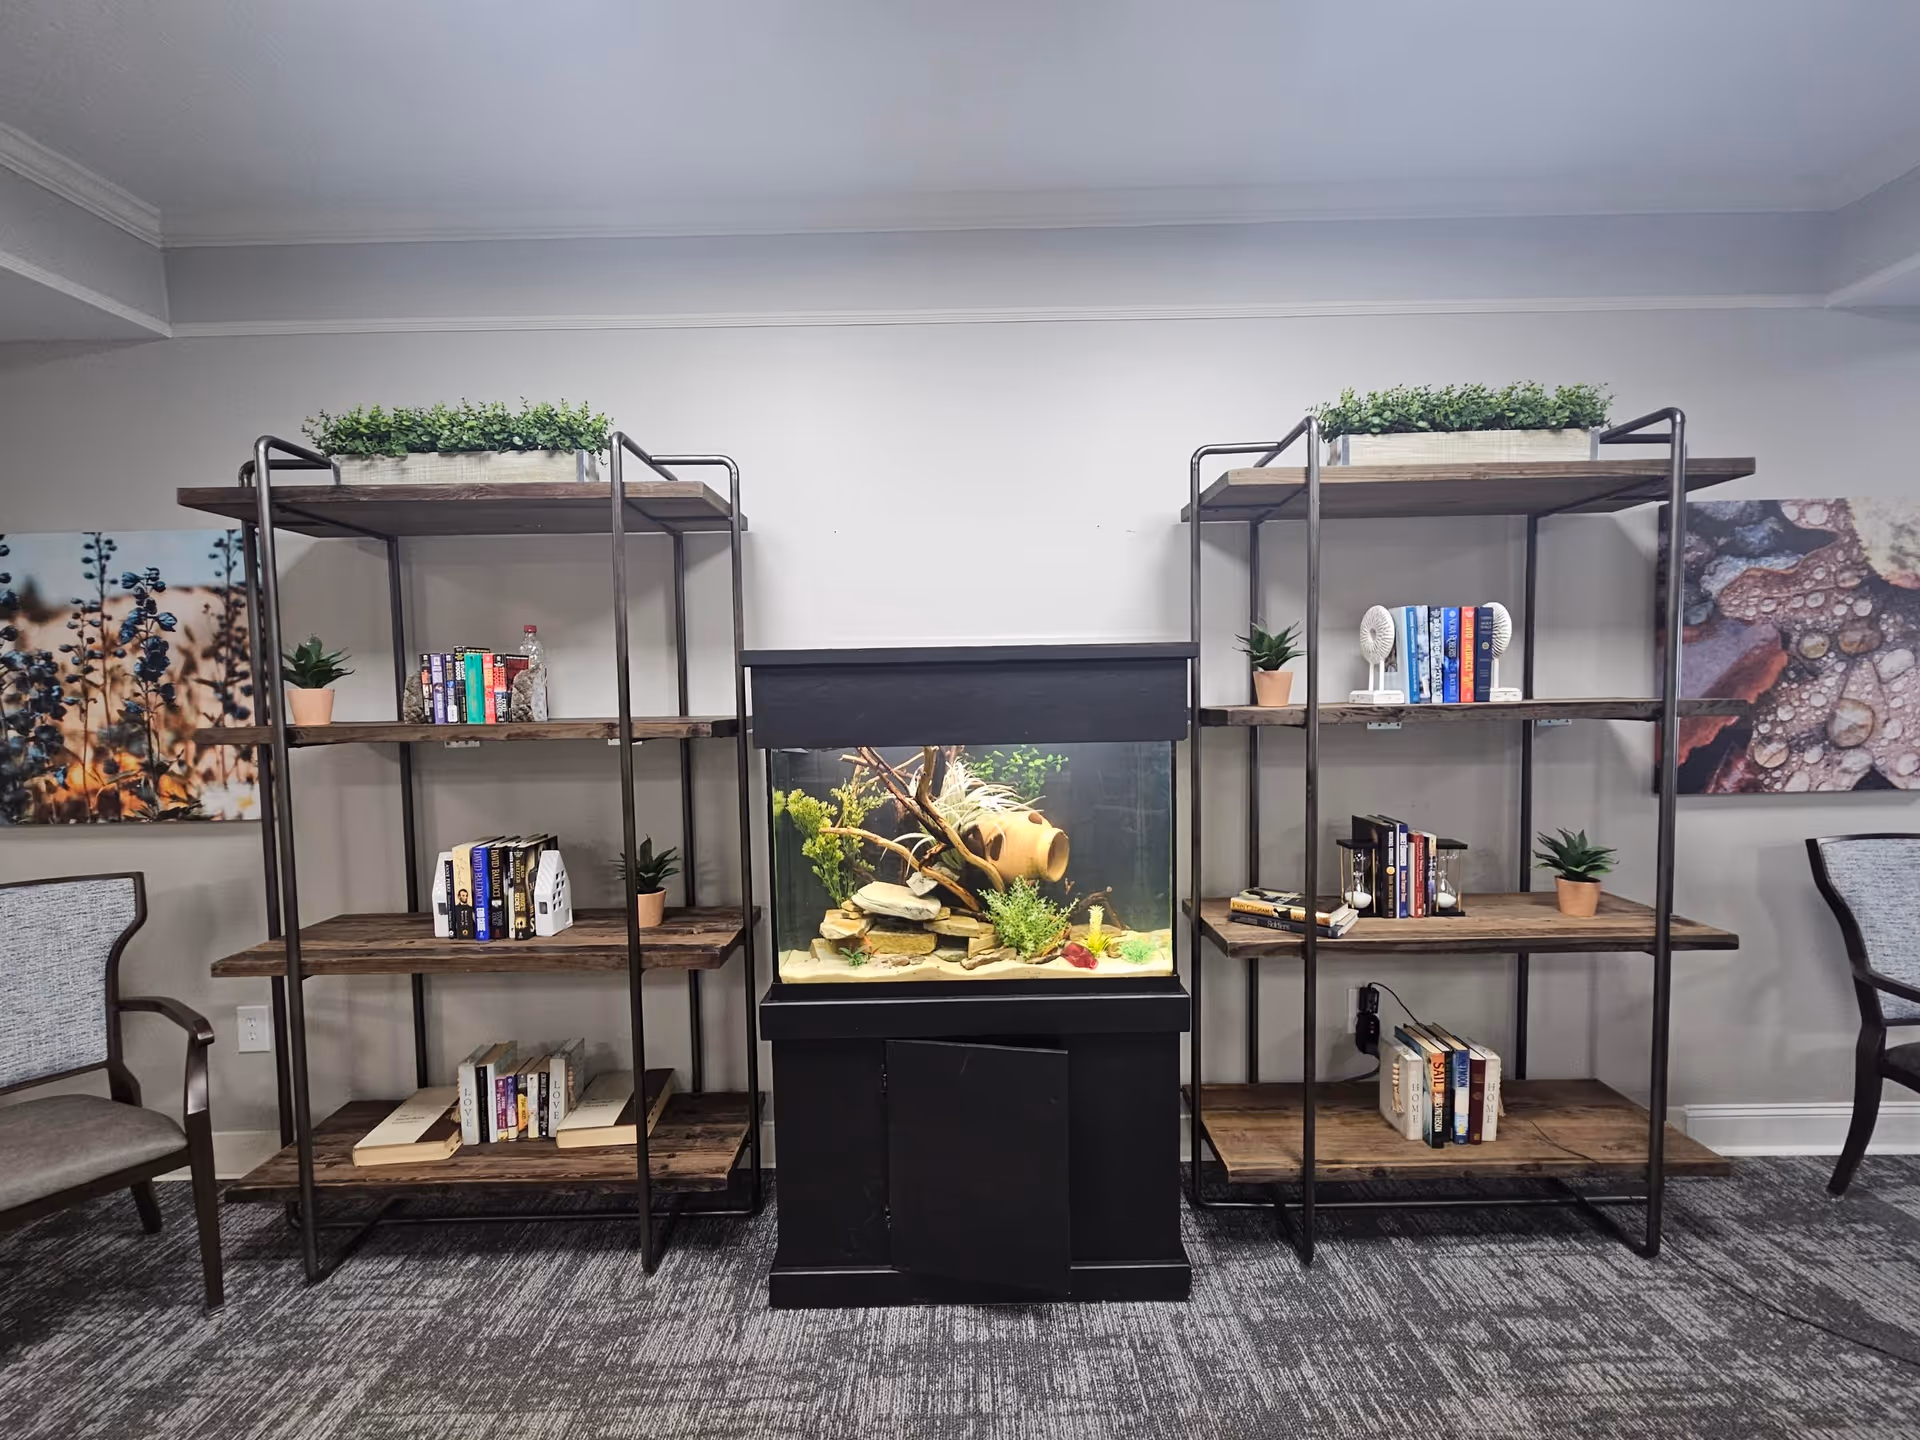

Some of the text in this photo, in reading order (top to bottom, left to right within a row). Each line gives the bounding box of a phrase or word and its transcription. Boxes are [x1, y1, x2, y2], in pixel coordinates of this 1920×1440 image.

[1446, 635, 1457, 657] ROBERTS
[473, 850, 484, 906] DAVID BALDACCI
[491, 849, 501, 897] DAVID BALDACCI
[1433, 1062, 1444, 1087] SAIL
[464, 1088, 472, 1127] LOVE
[553, 1081, 561, 1120] LOVE
[1434, 1107, 1442, 1132] PATTERSON
[1486, 1083, 1495, 1124] HOME
